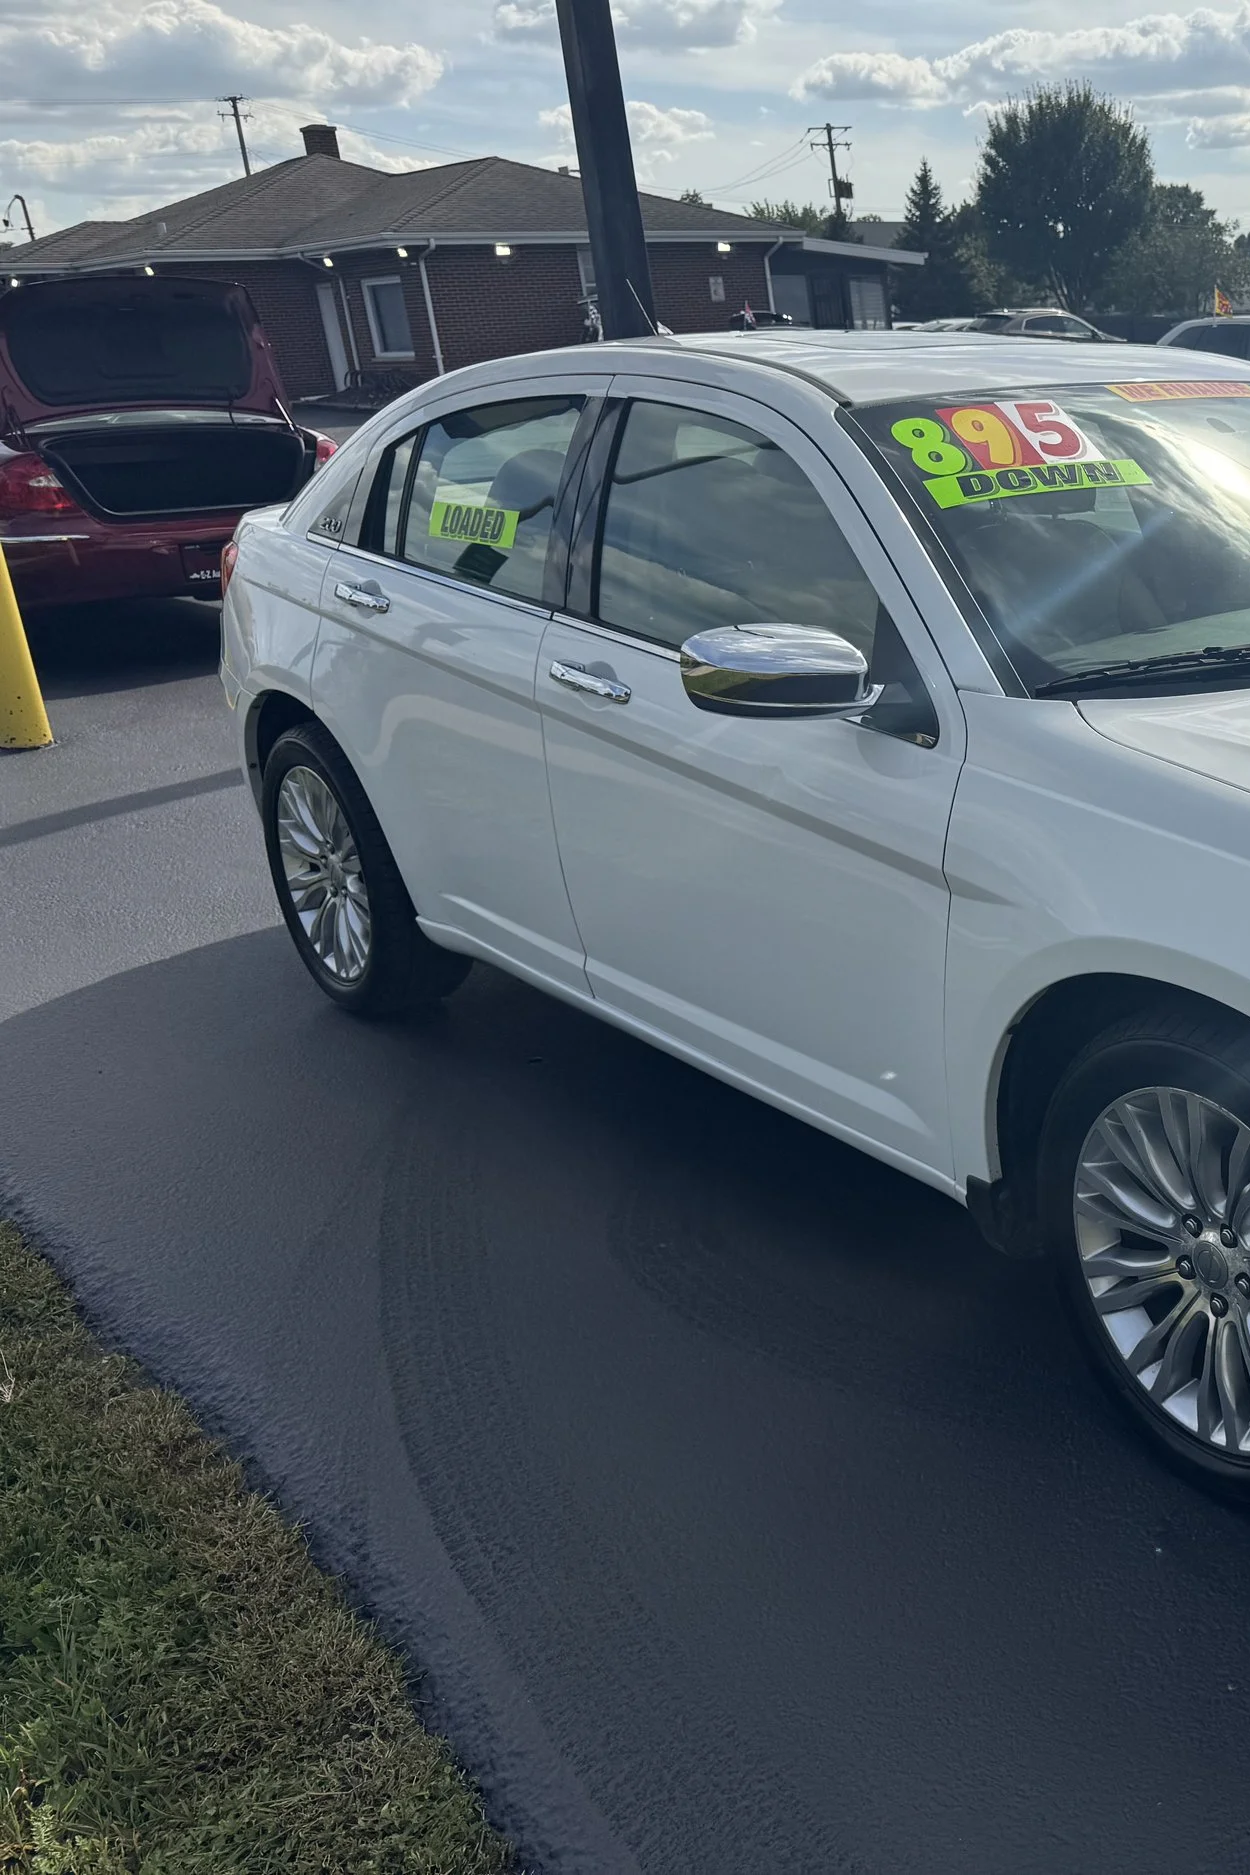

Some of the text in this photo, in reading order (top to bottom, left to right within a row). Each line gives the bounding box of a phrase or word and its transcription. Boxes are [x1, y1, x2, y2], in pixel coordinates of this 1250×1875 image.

[1114, 384, 1164, 400] WE
[891, 403, 1085, 475] 895
[956, 462, 1124, 499] DOWN
[319, 517, 342, 534] 200
[440, 504, 506, 544] LOADED
